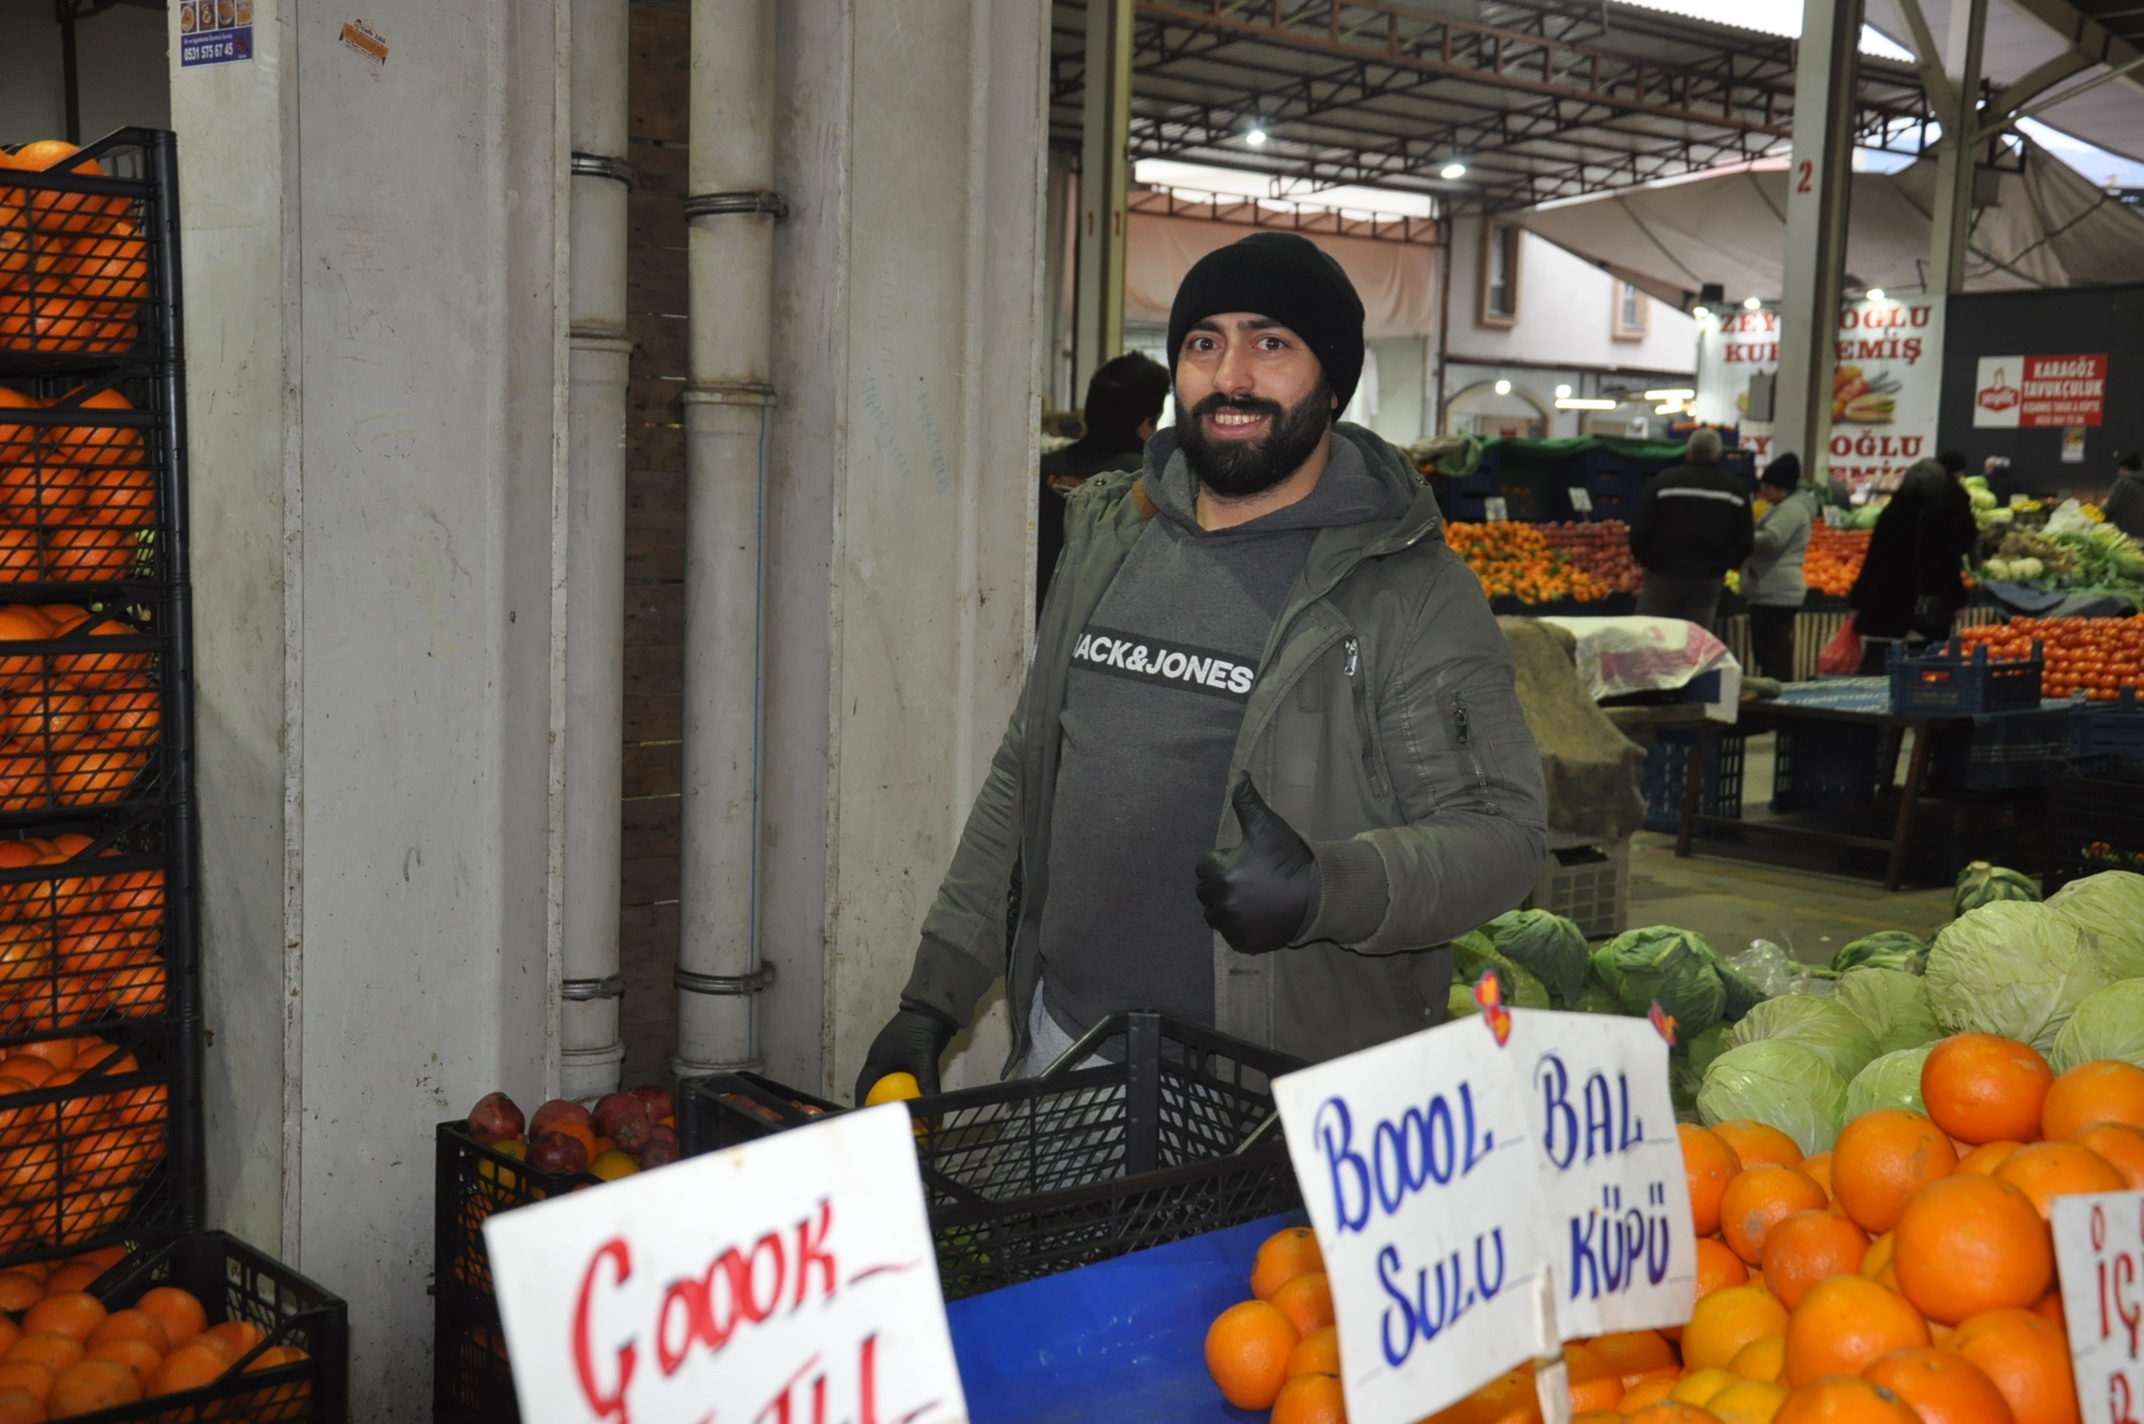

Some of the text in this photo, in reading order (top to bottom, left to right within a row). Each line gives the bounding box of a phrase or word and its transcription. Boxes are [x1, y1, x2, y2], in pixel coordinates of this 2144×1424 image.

[184, 42, 233, 61] 0531 575 67 45
[1797, 160, 1813, 193] 2
[2034, 356, 2096, 378] KARAGÖZ
[2024, 380, 2103, 398] TAVUKÇULUK
[1534, 1048, 1643, 1171] BAL
[1569, 1180, 1670, 1301] KÜPÜ
[1376, 1225, 1506, 1368] SULU
